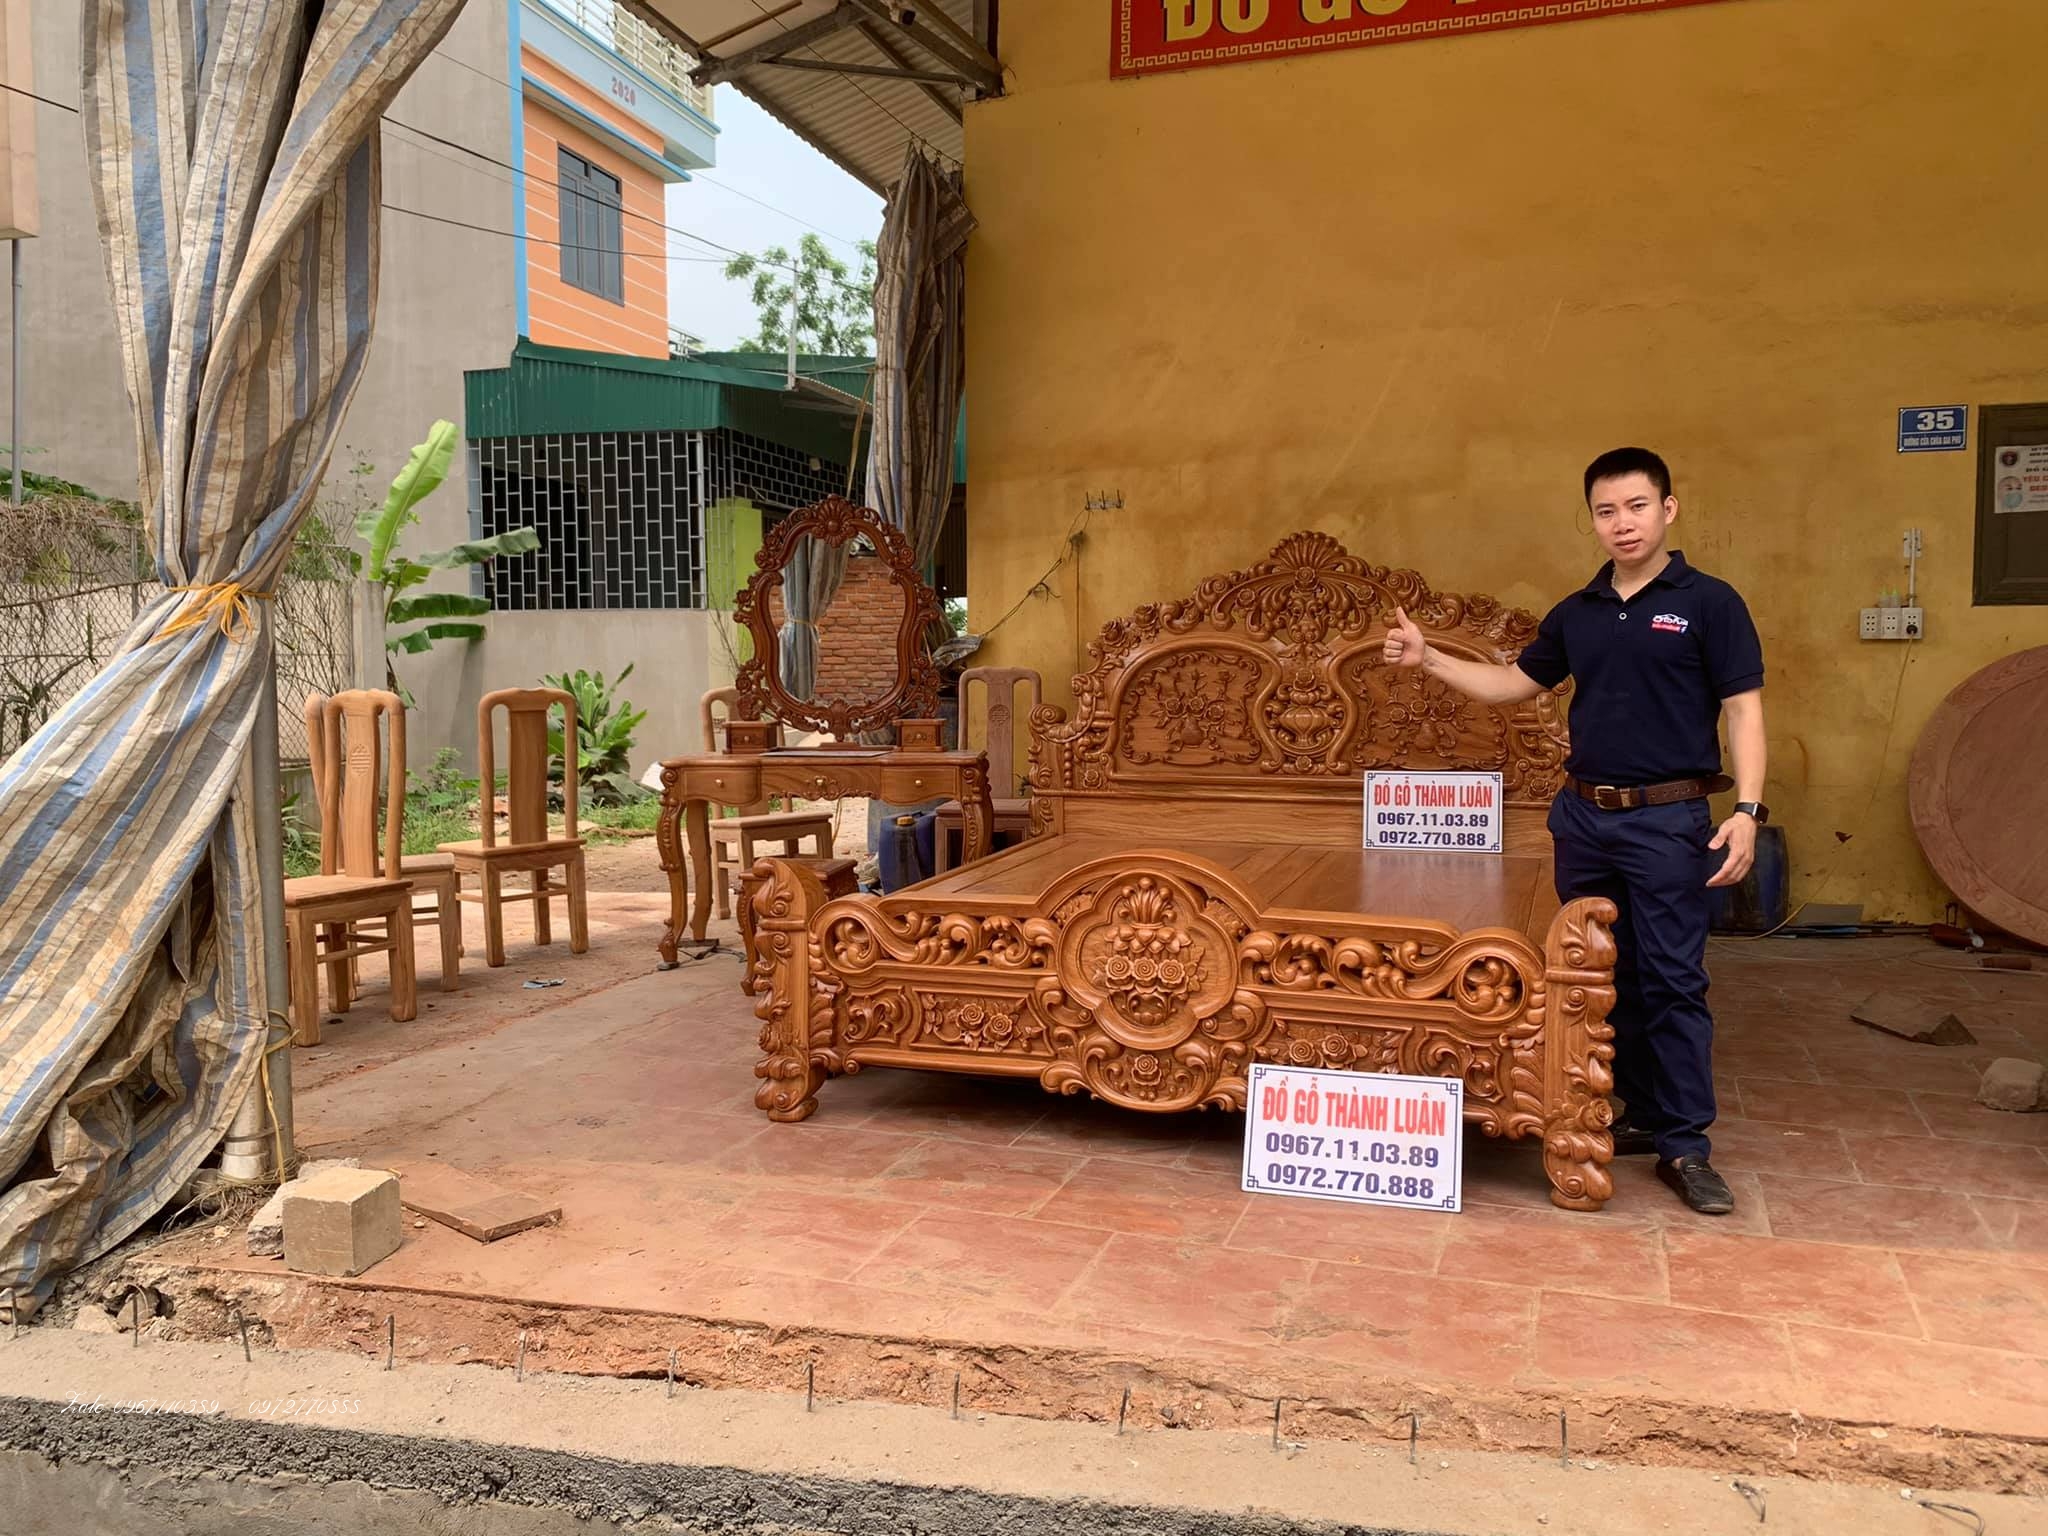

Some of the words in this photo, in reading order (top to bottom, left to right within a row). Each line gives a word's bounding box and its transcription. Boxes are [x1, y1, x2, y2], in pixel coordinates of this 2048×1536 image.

[612, 76, 636, 106] 2020
[1917, 411, 1954, 430] 35
[1374, 777, 1390, 806] ĐỒ
[1394, 776, 1411, 806] GỖ
[1415, 780, 1456, 807] THÀNH
[1460, 781, 1492, 808] LUÂN
[1377, 812, 1489, 827] 0967.11.03.89
[1379, 831, 1486, 846] 0972.770.888
[1263, 1076, 1289, 1121] ĐỒ
[1294, 1077, 1319, 1125] GỖ
[1325, 1086, 1388, 1131] THÀNH
[1394, 1092, 1446, 1136] LUÂN
[1265, 1132, 1439, 1168] 0967.11.03.89
[1267, 1163, 1434, 1199] 0972.770.888
